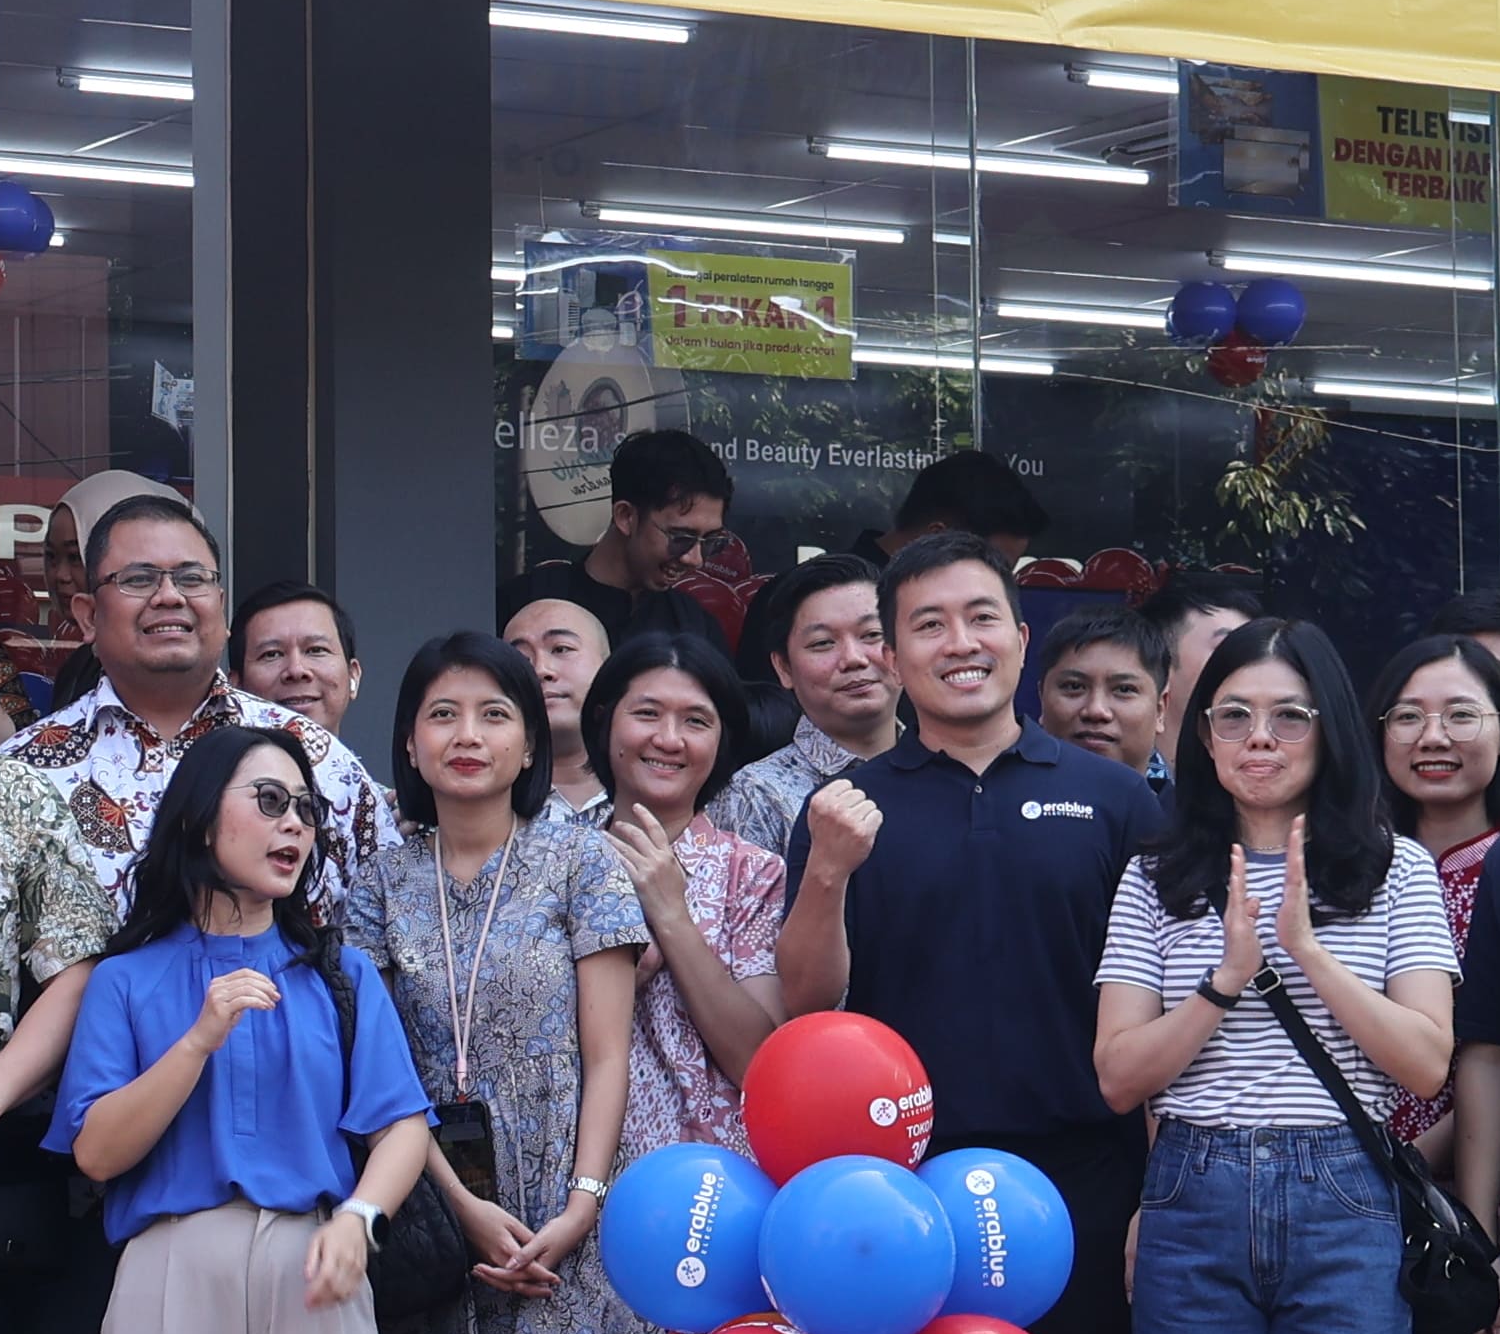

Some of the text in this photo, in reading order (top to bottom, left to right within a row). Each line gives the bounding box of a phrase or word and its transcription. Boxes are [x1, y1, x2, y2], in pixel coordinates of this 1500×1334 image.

[1333, 138, 1443, 171] DENGAN
[1383, 170, 1487, 204] TERBAIK
[714, 272, 764, 285] peralatan
[764, 274, 798, 286] rumah
[709, 337, 742, 349] bulan
[765, 341, 803, 354] produk
[745, 438, 822, 469] Beauty
[1003, 452, 1044, 476] You
[1042, 801, 1094, 815] erablue
[686, 1169, 720, 1254] erablue
[982, 1197, 1008, 1288] erablue
